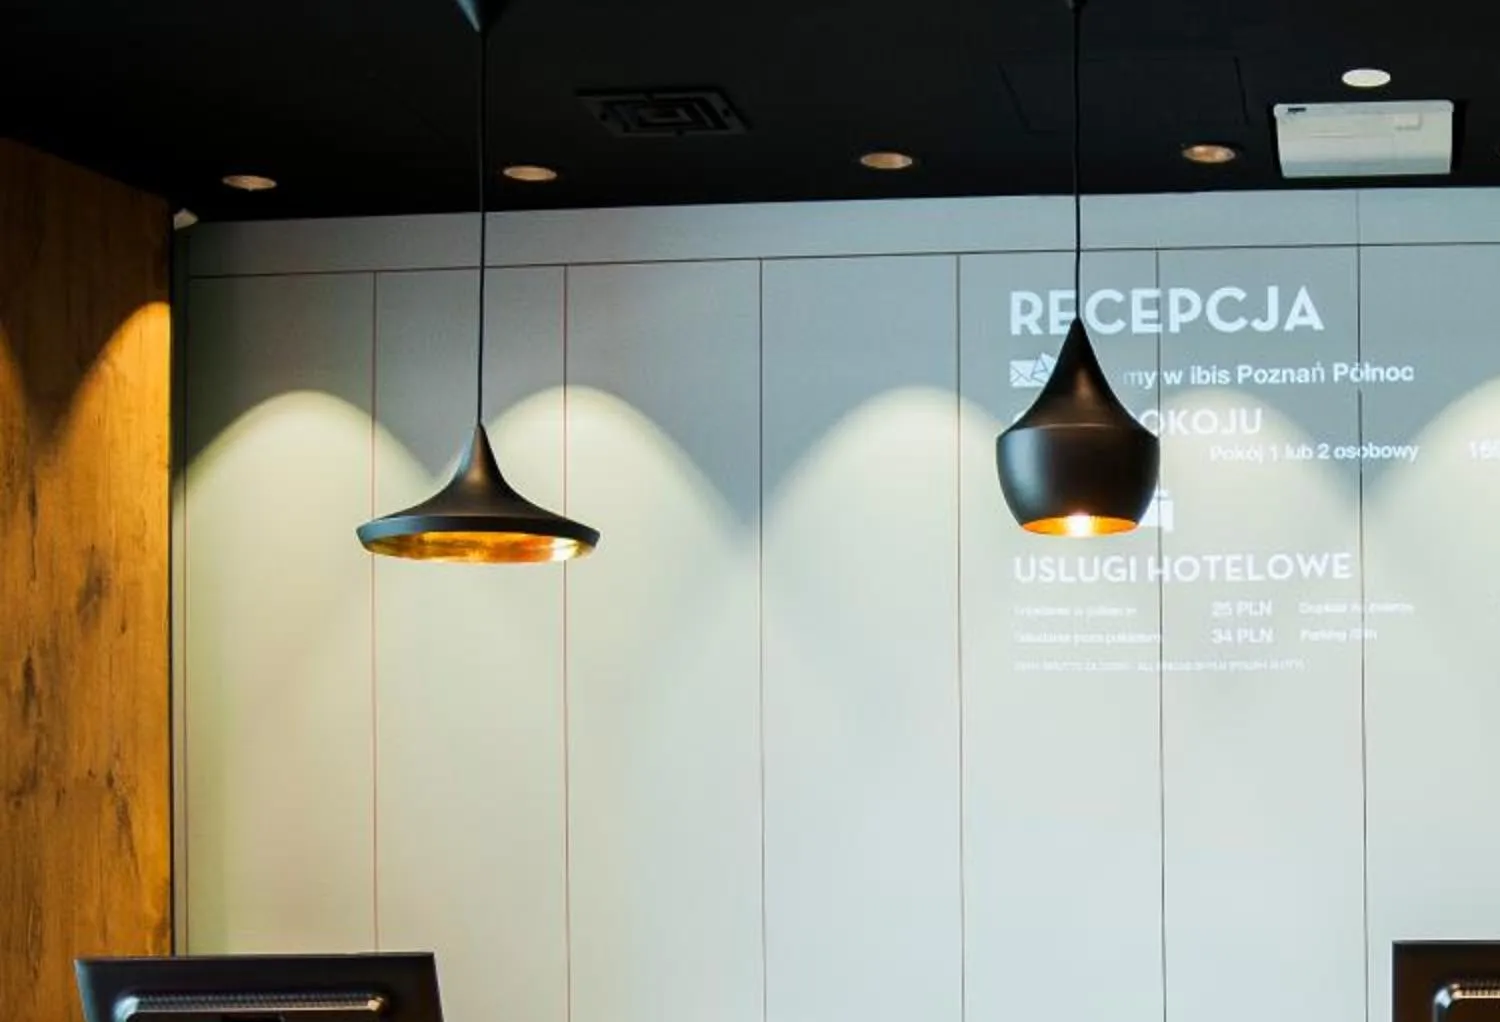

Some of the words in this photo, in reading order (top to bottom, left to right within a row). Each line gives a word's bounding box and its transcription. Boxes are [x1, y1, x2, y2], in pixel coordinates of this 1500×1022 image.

[1010, 285, 1325, 336] RECEPCJA
[1163, 369, 1183, 385] w
[1190, 364, 1231, 385] ibis
[1237, 361, 1325, 385] Poznań
[1333, 361, 1415, 385] Północ
[1139, 407, 1263, 436] OKOJU
[1269, 444, 1279, 461] 1
[1285, 442, 1314, 460] lub
[1317, 442, 1331, 460] 2
[1333, 442, 1420, 463] osobowy
[1148, 551, 1353, 583] HOTELOWE
[1237, 599, 1273, 617] PLN
[1237, 626, 1274, 644] PLN
